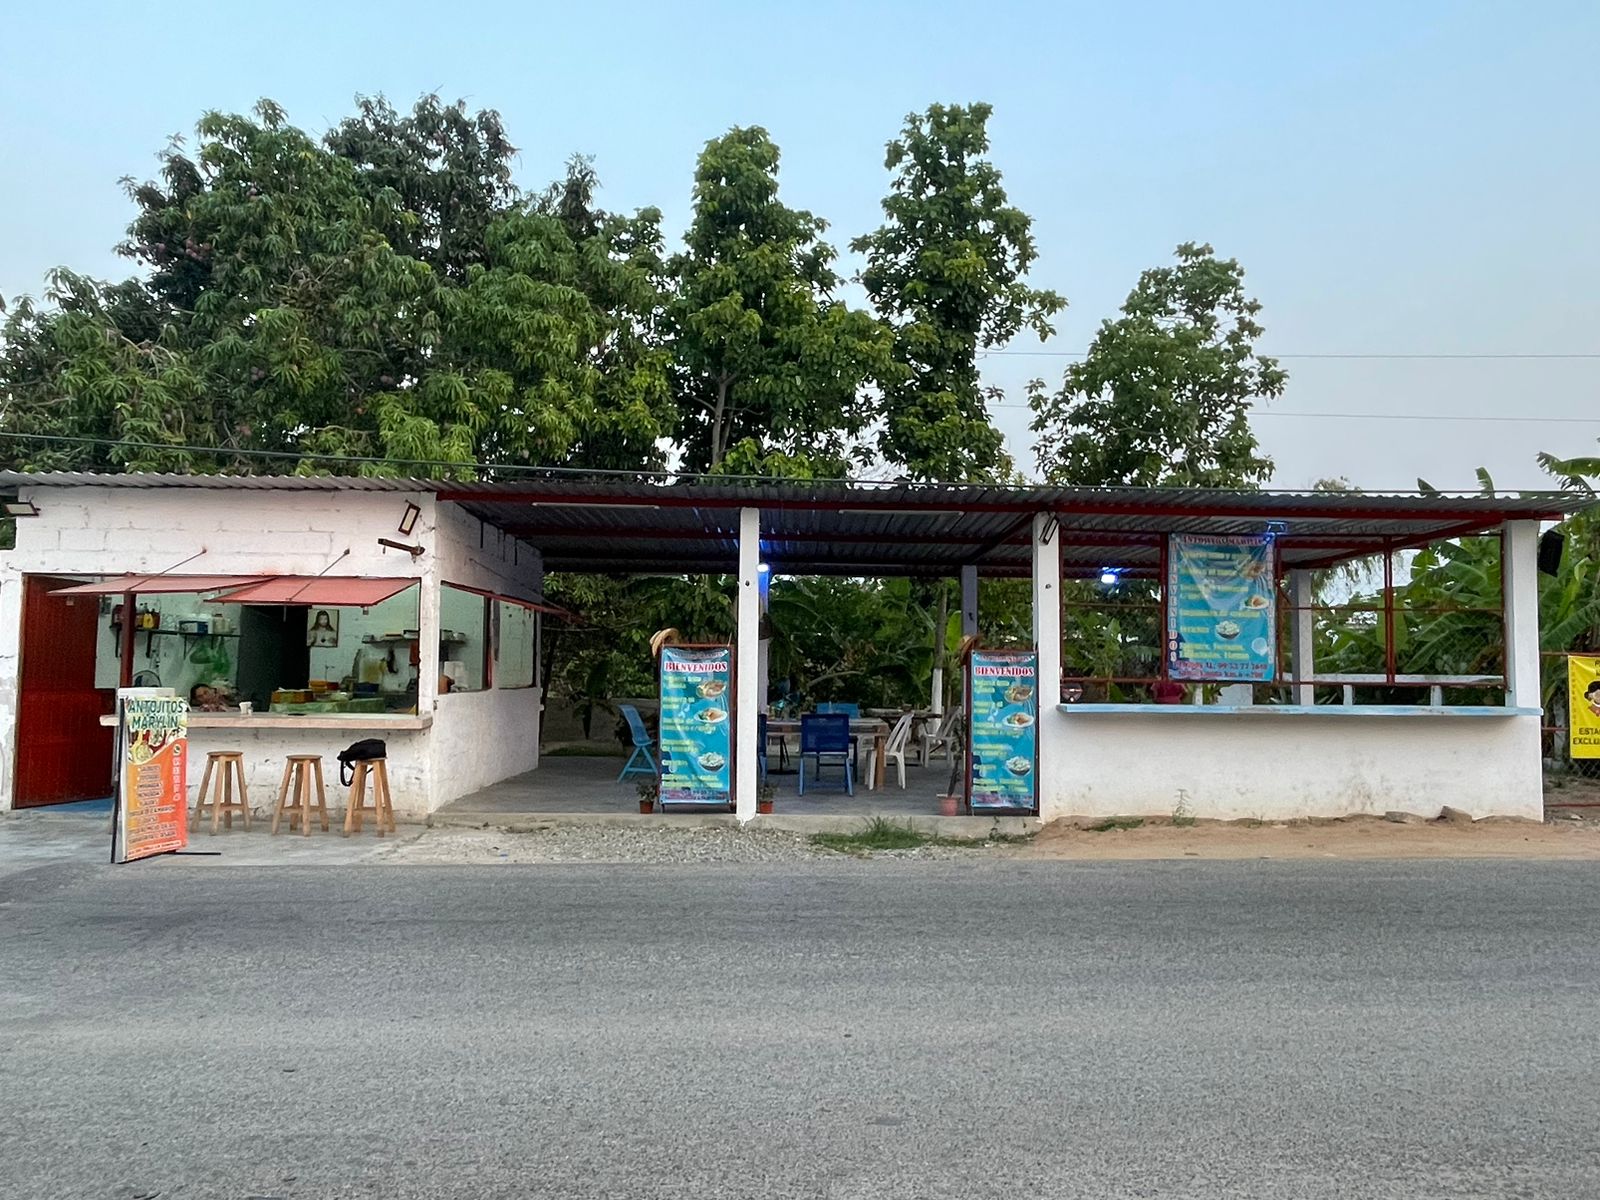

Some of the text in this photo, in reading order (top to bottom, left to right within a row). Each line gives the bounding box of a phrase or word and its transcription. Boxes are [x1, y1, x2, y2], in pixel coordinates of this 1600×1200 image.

[665, 661, 728, 672] BIENVENIDOS
[975, 666, 1035, 676] BIENVENIDOS
[128, 700, 183, 713] ANTOJITOS
[132, 715, 178, 729] MARYLIN
[1579, 727, 1600, 736] ESTA
